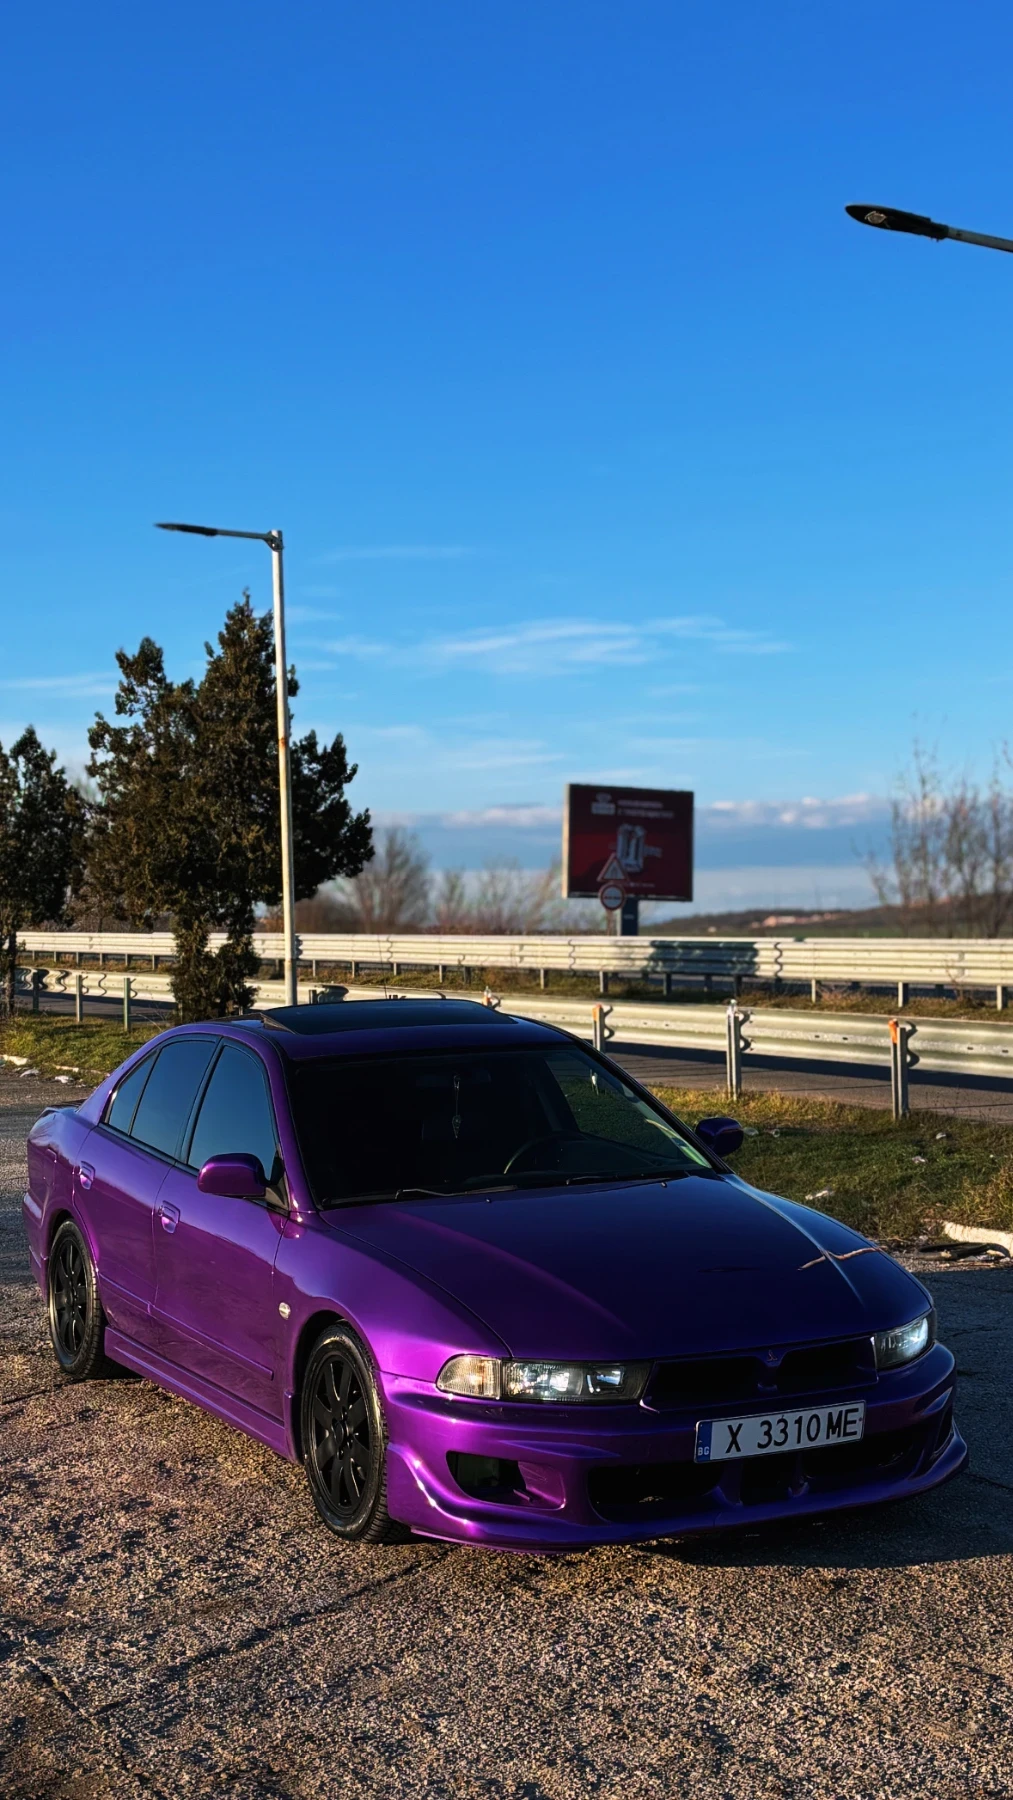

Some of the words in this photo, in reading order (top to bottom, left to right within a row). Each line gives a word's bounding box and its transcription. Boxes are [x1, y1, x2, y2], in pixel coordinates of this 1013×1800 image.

[725, 1423, 743, 1454] X
[757, 1414, 821, 1449] 3310
[826, 1408, 859, 1440] ME
[697, 1446, 710, 1456] BG
